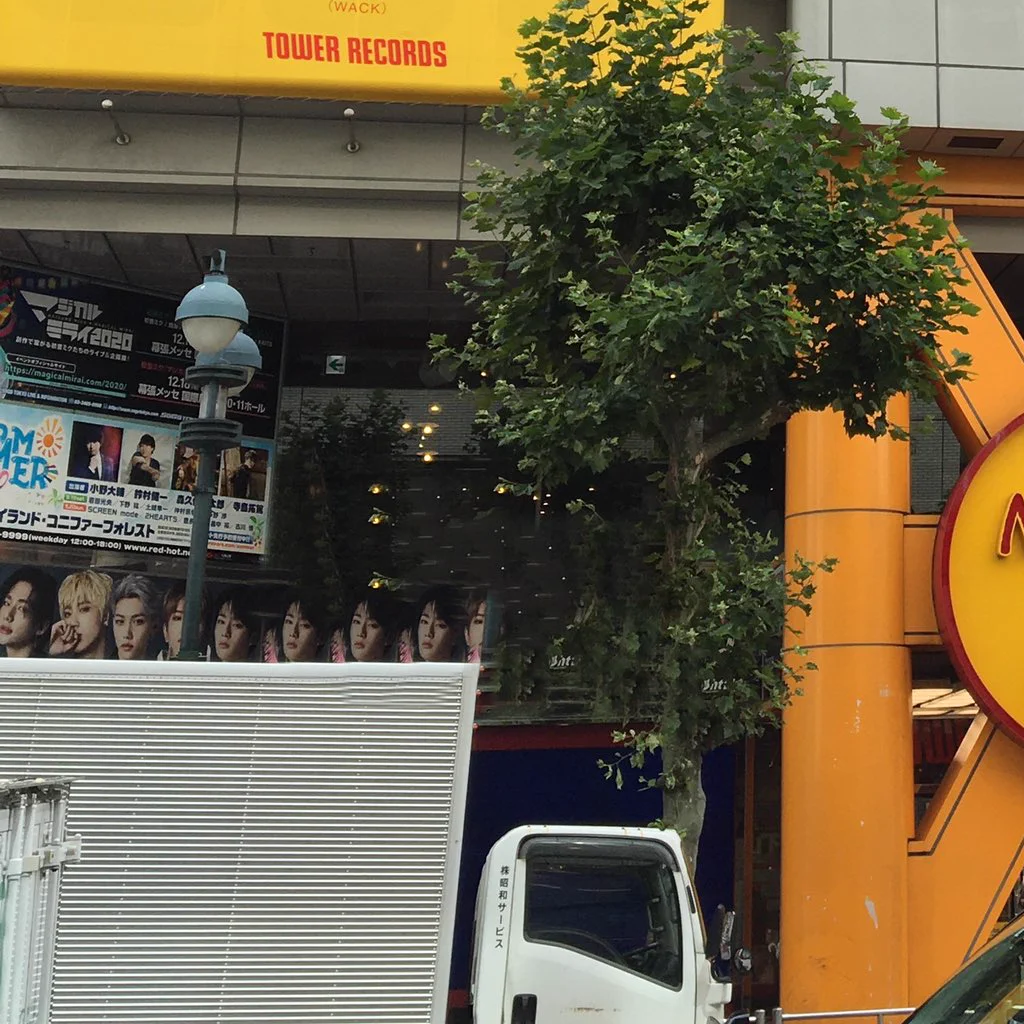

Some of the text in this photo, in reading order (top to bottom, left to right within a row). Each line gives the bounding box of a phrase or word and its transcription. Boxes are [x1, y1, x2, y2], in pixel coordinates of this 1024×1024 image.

[262, 32, 447, 68] TOWER RECORDS
[88, 505, 117, 515] SCREEN
